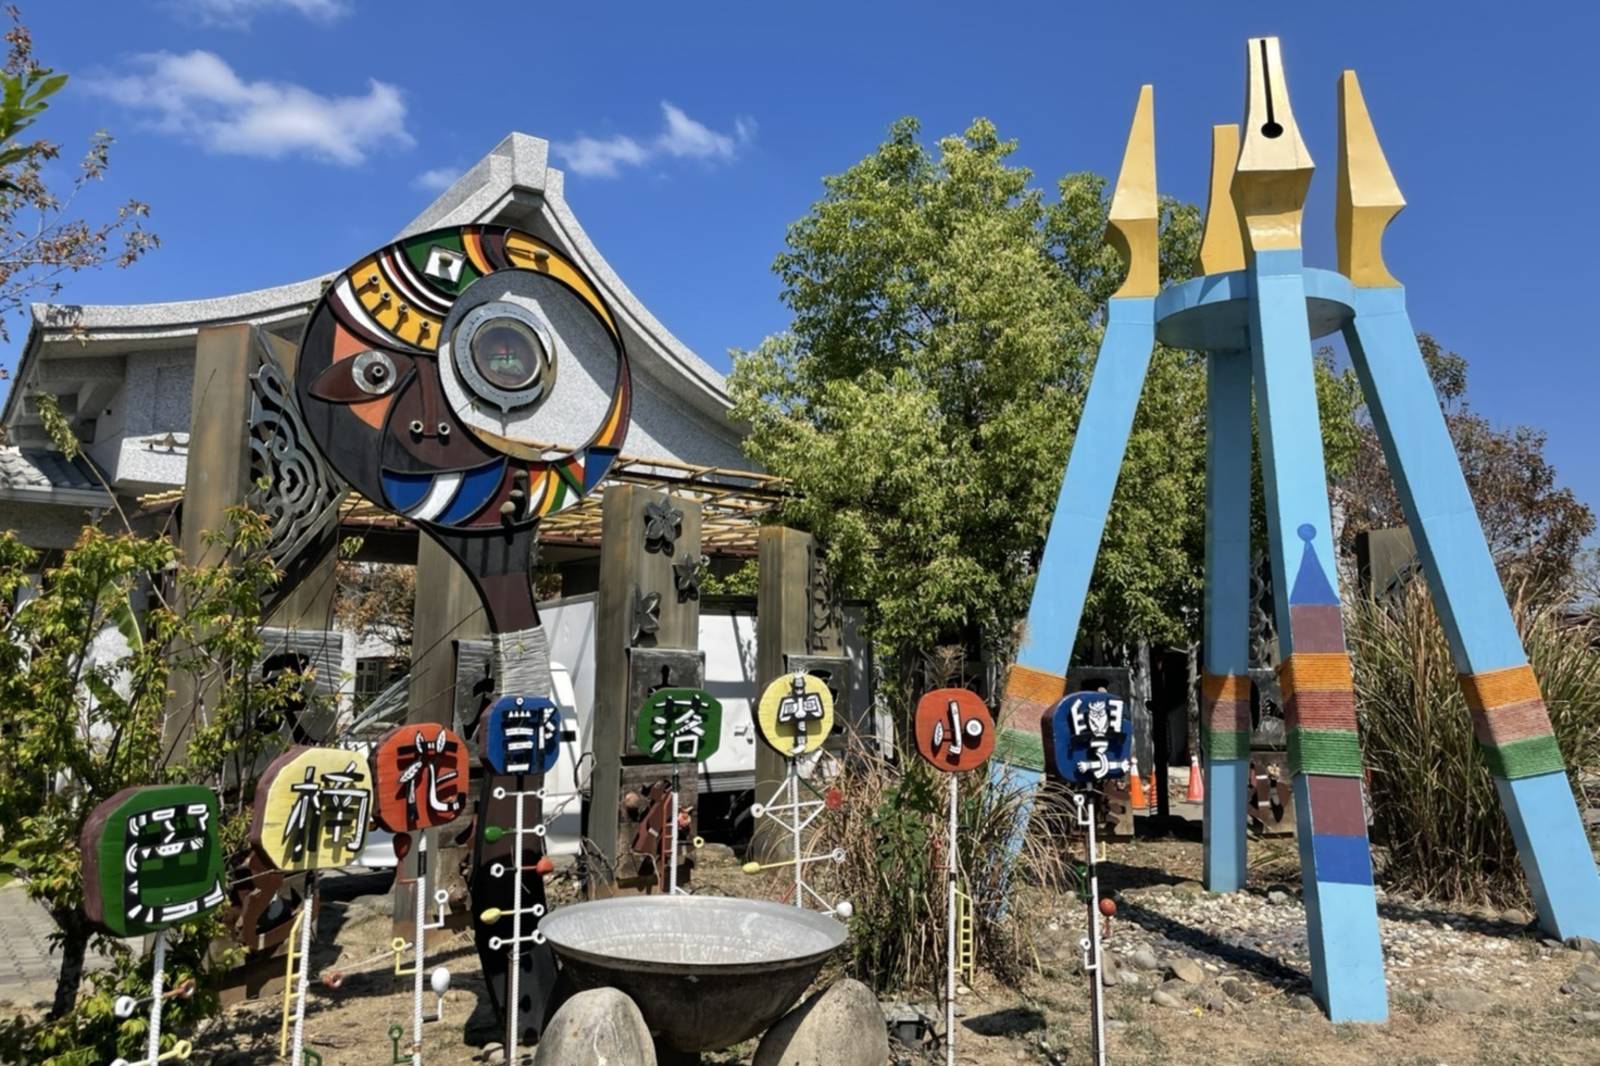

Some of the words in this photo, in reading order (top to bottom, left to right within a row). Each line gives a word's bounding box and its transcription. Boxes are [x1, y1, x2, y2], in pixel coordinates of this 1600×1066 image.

[503, 697, 557, 772] 部
[651, 695, 710, 758] 落
[932, 700, 984, 755] 小
[1063, 698, 1131, 778] 學
[397, 730, 466, 820] 花
